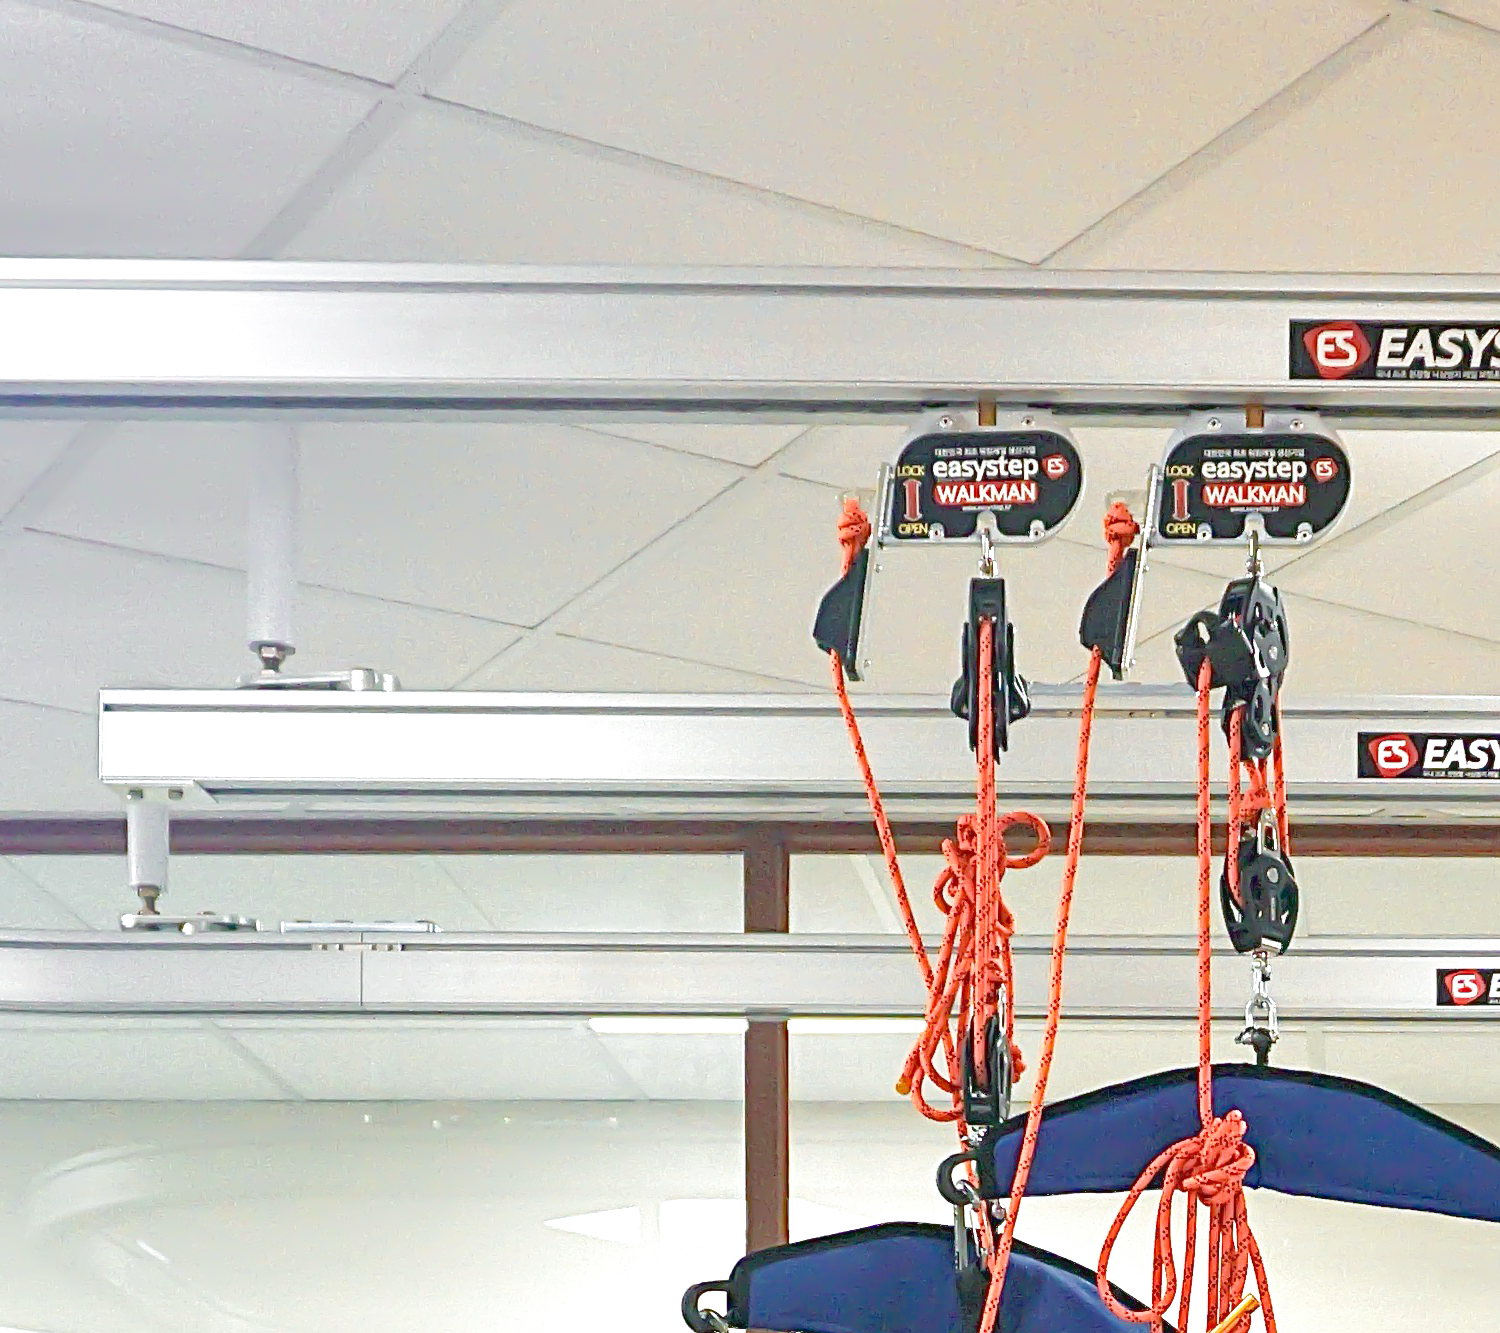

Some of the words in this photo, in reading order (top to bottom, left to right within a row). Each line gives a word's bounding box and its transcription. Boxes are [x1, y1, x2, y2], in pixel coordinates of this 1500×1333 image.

[897, 465, 925, 477] LOCK
[932, 456, 1039, 481] easystep
[1166, 465, 1195, 477] LOCK
[1201, 458, 1308, 483] easystep
[936, 483, 1036, 503] WALKMAN
[1205, 485, 1304, 504] WALKMAN
[898, 523, 928, 535] OPEN
[1166, 523, 1196, 535] OPEN
